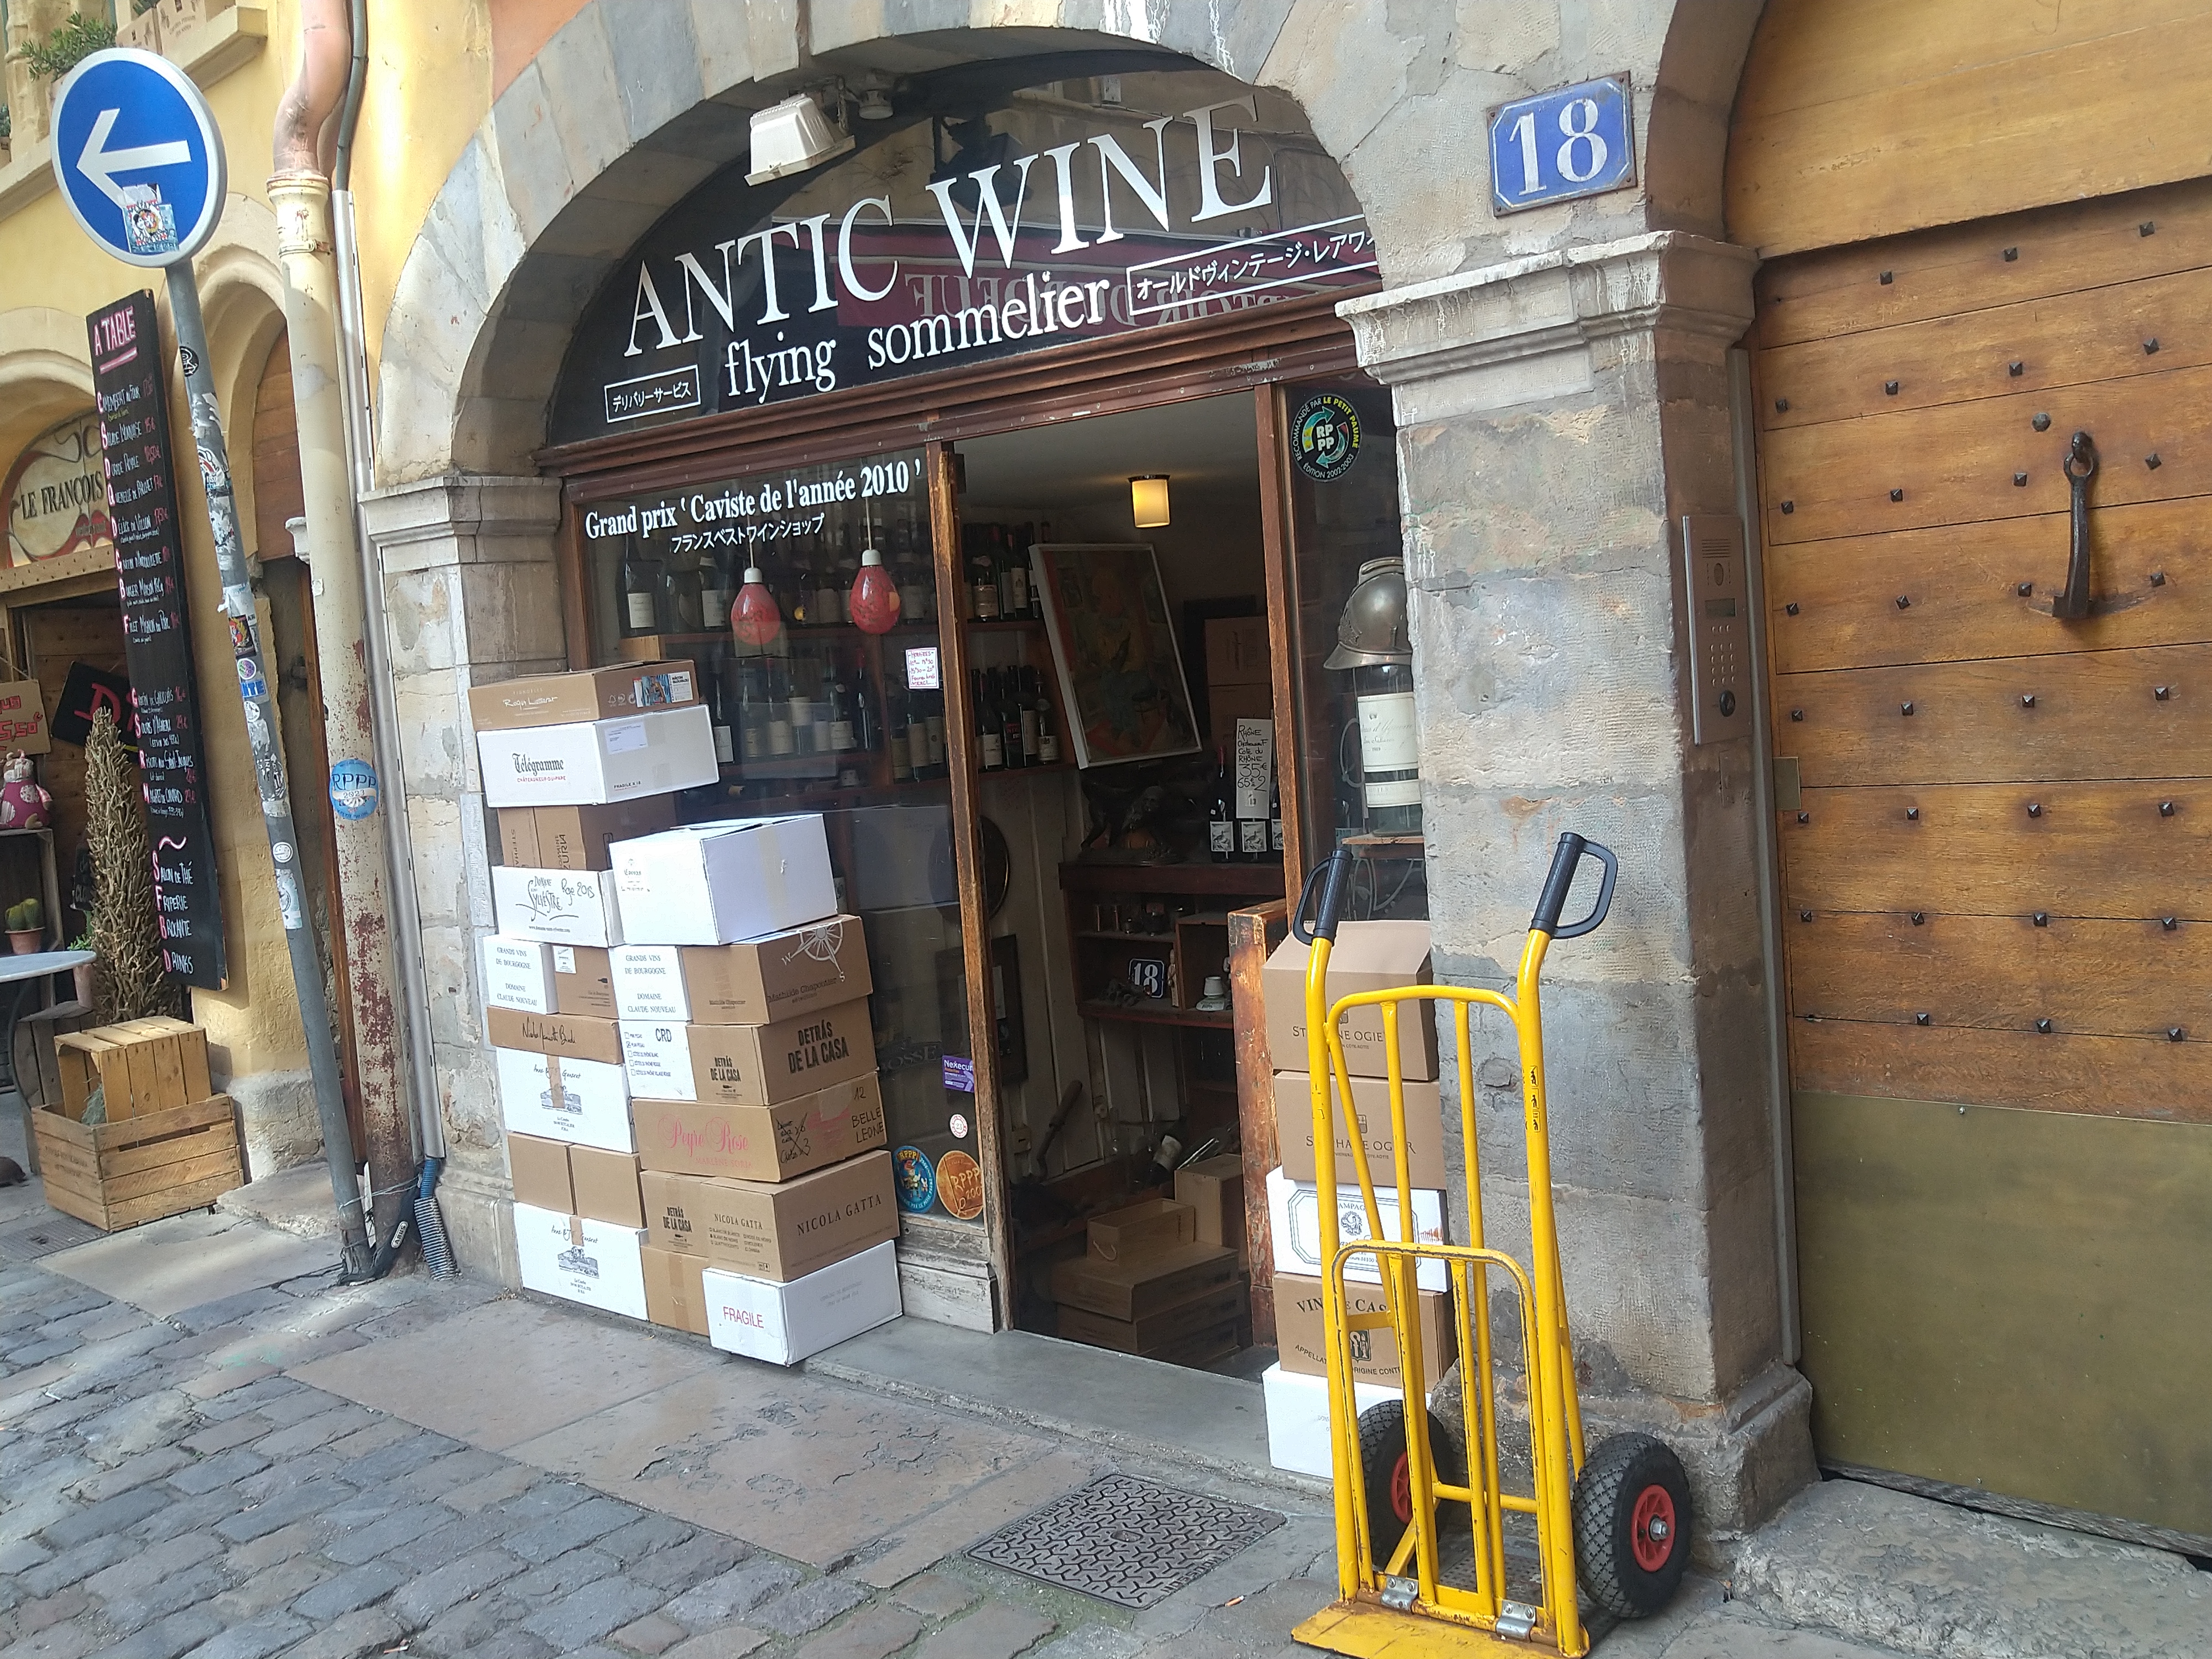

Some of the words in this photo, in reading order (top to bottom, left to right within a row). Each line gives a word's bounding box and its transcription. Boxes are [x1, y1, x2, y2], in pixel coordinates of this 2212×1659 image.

[1509, 98, 1608, 196] 18
[624, 194, 899, 357] ANTIC
[926, 95, 1272, 278] WINE
[93, 324, 103, 356] A
[101, 305, 137, 352] TABLE
[724, 331, 837, 403] flying
[868, 272, 1110, 370] sommelier
[612, 381, 692, 413] デリバリーサービス
[1310, 398, 1322, 409] PAR
[1333, 398, 1352, 415] PETIT
[1349, 415, 1359, 448] PAUMÉ
[1316, 424, 1333, 439] RP
[1317, 437, 1334, 451] PP
[1303, 462, 1326, 478] ÉDITION
[21, 492, 37, 520] LE
[586, 505, 638, 539] Grand
[641, 500, 678, 538] prix
[690, 487, 755, 523] Caviste
[759, 483, 781, 513] de
[787, 470, 855, 509] l'année
[860, 460, 909, 497] 2010
[671, 512, 825, 554] フランスベストワインショップ
[1238, 725, 1262, 741] RHÔNE
[512, 753, 565, 776] Télégramme
[332, 773, 376, 791] RPPP
[155, 885, 189, 912] FRIPERIE
[781, 952, 792, 966] W
[839, 972, 846, 982] S
[1133, 962, 1159, 997] 18
[655, 1028, 672, 1042] CRD
[798, 1019, 833, 1046] DETRÁS
[1354, 1031, 1385, 1042] OGIE
[714, 1055, 733, 1068] DETRÁS
[788, 1051, 804, 1074] DE
[805, 1045, 820, 1069] LA
[821, 1036, 850, 1064] CASA
[710, 1067, 718, 1081] DE
[718, 1068, 726, 1081] LA
[726, 1068, 742, 1082] CASA
[854, 1086, 867, 1100] 12
[852, 1106, 882, 1128] BELLE
[657, 1113, 705, 1157] Peyre
[705, 1117, 749, 1154] Rose
[856, 1121, 884, 1143] LEONE
[899, 1150, 917, 1159] RPPP
[950, 1166, 980, 1191] RPPP
[966, 1186, 982, 1200] 200
[666, 1206, 684, 1218] DETRÁS
[714, 1213, 739, 1226] NICOLA
[741, 1218, 763, 1230] GATTA
[797, 1209, 841, 1236] NICOLA
[846, 1194, 881, 1217] GATTA
[394, 1225, 406, 1245] ABUS
[663, 1215, 671, 1229] DE
[670, 1217, 678, 1230] LA
[678, 1218, 692, 1233] CASA
[723, 1306, 764, 1328] FRAGILE
